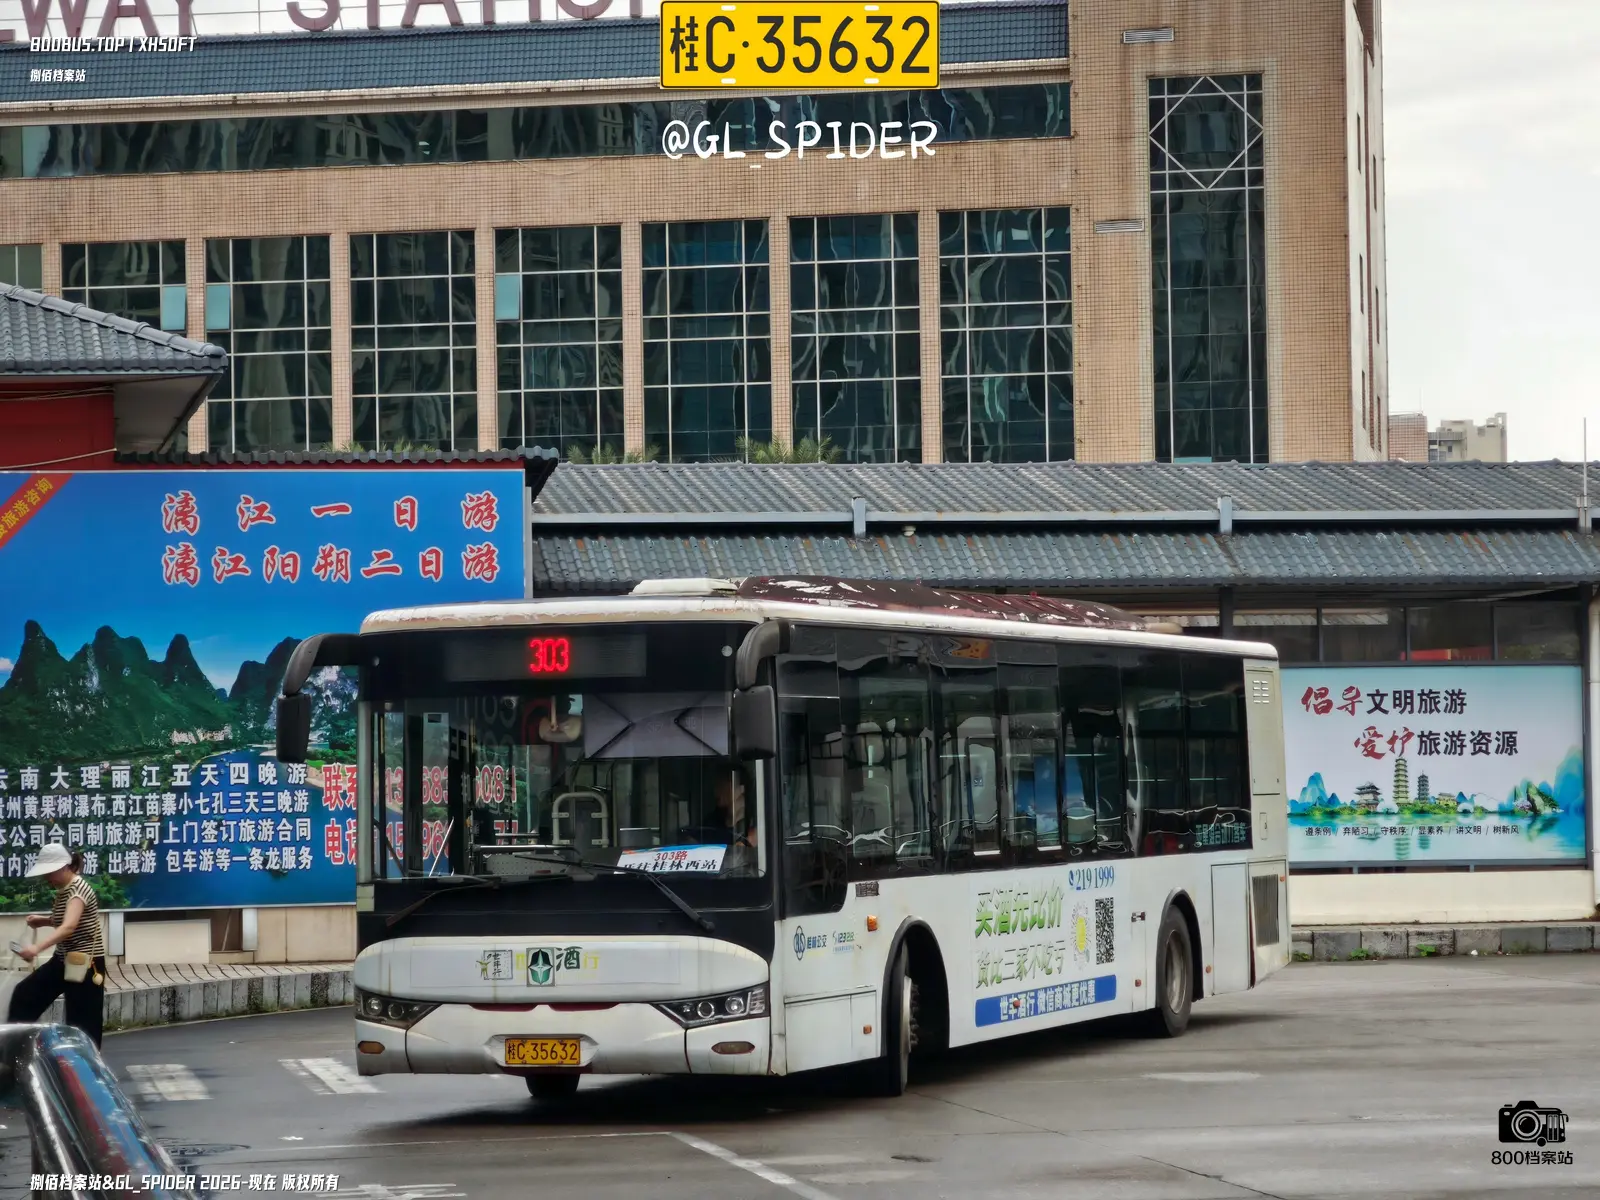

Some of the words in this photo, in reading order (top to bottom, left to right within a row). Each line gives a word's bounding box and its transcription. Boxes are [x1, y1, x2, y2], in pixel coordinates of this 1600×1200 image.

[162, 490, 500, 536] 漓江一日游
[162, 541, 500, 587] 漓江阳朔二日游
[529, 637, 569, 673] 303
[1300, 685, 1468, 716] 倡导文明旅游
[1353, 725, 1519, 760] 爱护旅游资源
[0, 791, 310, 819] 州黄果树瀑布.西江苗寨小七孔三天三晚游
[1305, 827, 1332, 837] 遵条例
[1456, 826, 1482, 836] 讲文明
[1493, 825, 1519, 836] 树新风
[109, 850, 157, 875] 出境游
[166, 846, 313, 873] 包车游等一条龙服务
